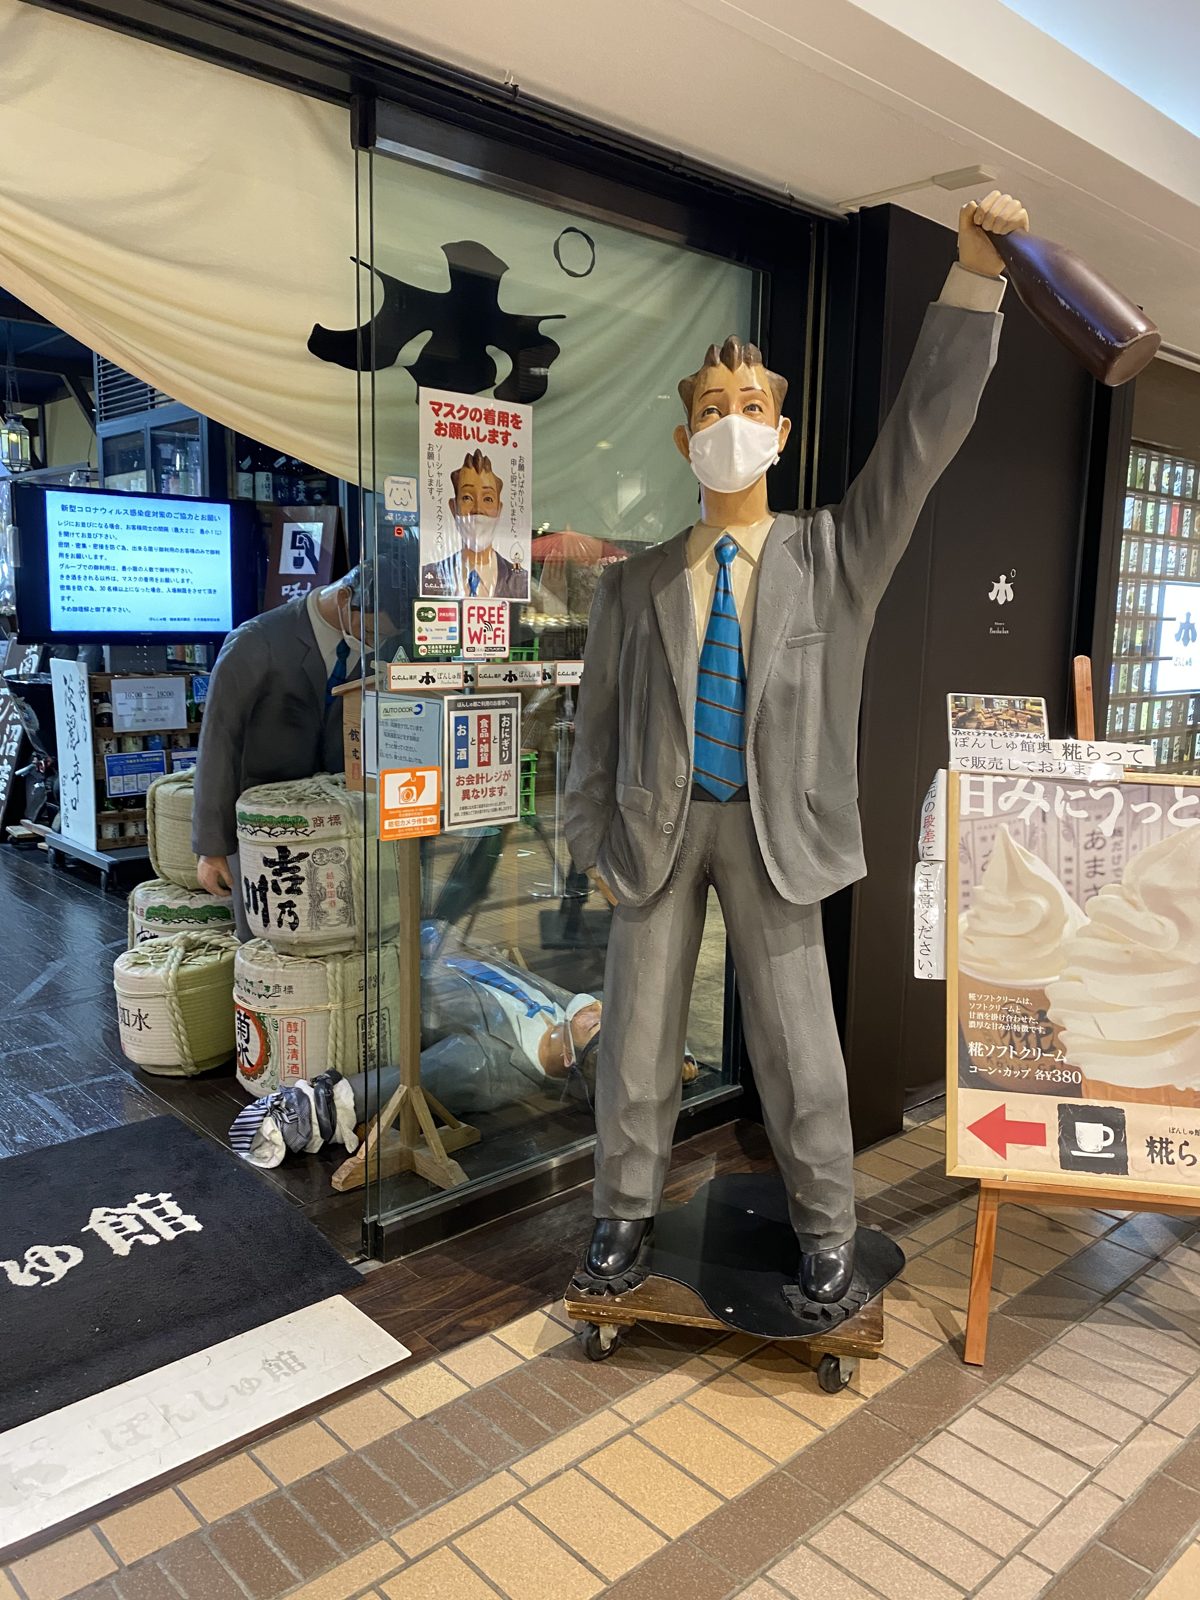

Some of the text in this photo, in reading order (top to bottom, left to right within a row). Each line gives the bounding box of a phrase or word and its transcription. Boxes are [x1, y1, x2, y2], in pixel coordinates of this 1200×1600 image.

[428, 400, 523, 430] マスクの着用を
[433, 420, 518, 448] お願いします。
[467, 606, 504, 624] FREE
[467, 626, 505, 645] Wi-Fi
[501, 715, 510, 762] おにぎり
[954, 736, 1145, 765] ぽんしゅ館奥 糀らって
[455, 769, 512, 787] お会計レジが
[461, 785, 508, 801] 異なります。
[917, 861, 935, 979] ご注意ください。
[968, 992, 1033, 1006] 糀ソフトクリームは、
[969, 1002, 1021, 1014] ソフトクリームと
[286, 1021, 300, 1075] 醇良清酒
[968, 1041, 1067, 1063] 糀ソフトクリーム
[969, 1064, 1031, 1079] コーン・カップ
